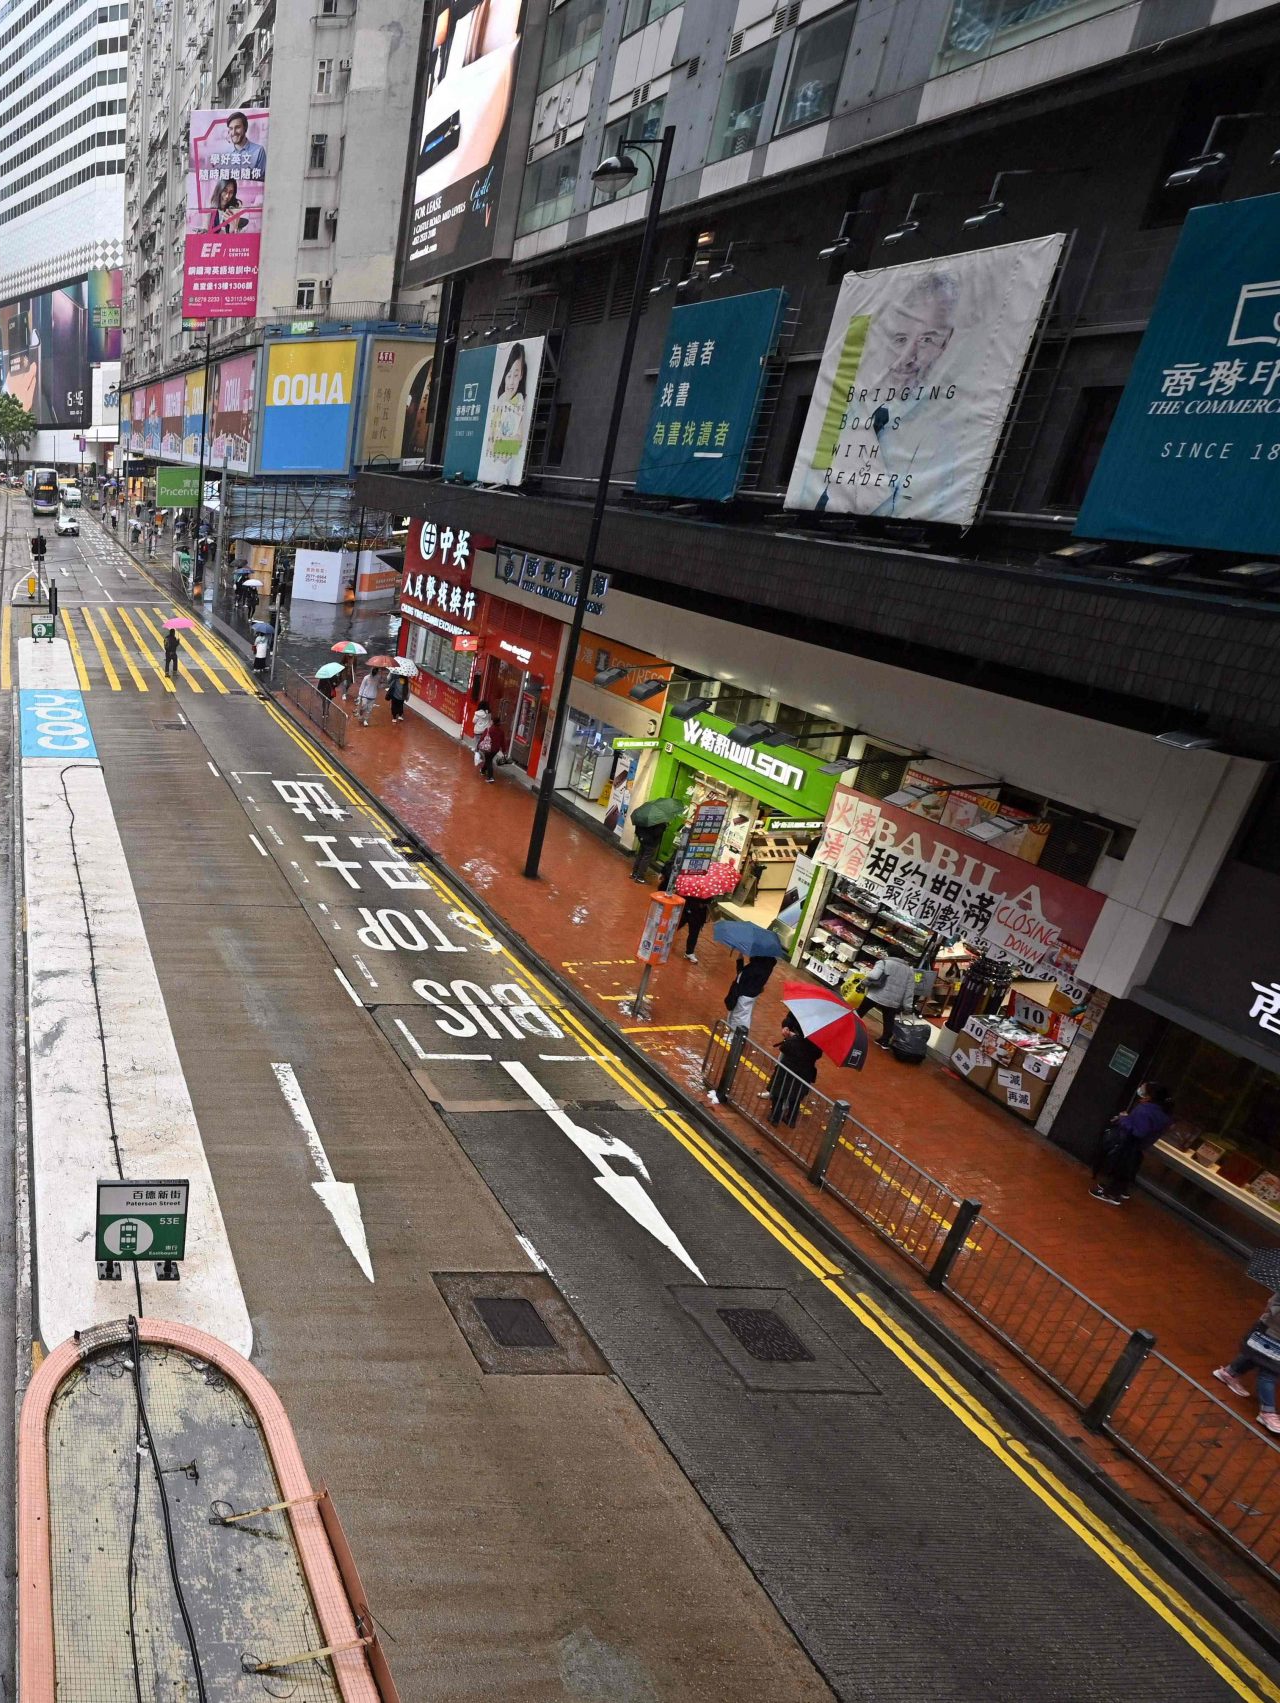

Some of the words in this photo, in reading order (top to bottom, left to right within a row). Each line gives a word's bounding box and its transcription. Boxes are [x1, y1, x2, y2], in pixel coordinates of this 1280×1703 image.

[210, 153, 252, 165] 學好英文
[426, 195, 442, 215] LEASE
[200, 242, 222, 258] EF
[669, 339, 715, 368] 為讀者
[273, 372, 345, 406] OOHA
[660, 382, 690, 408] 找書
[846, 384, 956, 403] BRIDGING
[1147, 400, 1184, 415] THE
[652, 420, 730, 446] 為書找讀者
[839, 414, 903, 431] BOOS
[831, 444, 880, 460] WITH
[1161, 442, 1234, 460] SINCE
[824, 467, 913, 489] READERS
[440, 526, 471, 570] 中英
[700, 727, 731, 759] 衛訊
[730, 741, 805, 791] WILSON
[832, 796, 877, 844] 火速
[302, 835, 432, 889] 巴士
[874, 816, 1047, 922] BABILA
[866, 847, 995, 934] 租約期滿
[883, 877, 961, 936] 最後倒數
[357, 907, 504, 955] STOP
[997, 905, 1058, 946] CLOSING
[1004, 933, 1043, 962] DOWN
[412, 979, 565, 1039] BUS
[1007, 1090, 1030, 1106] 再減
[133, 1190, 181, 1200] 百德新街
[159, 1217, 180, 1225] 53E
